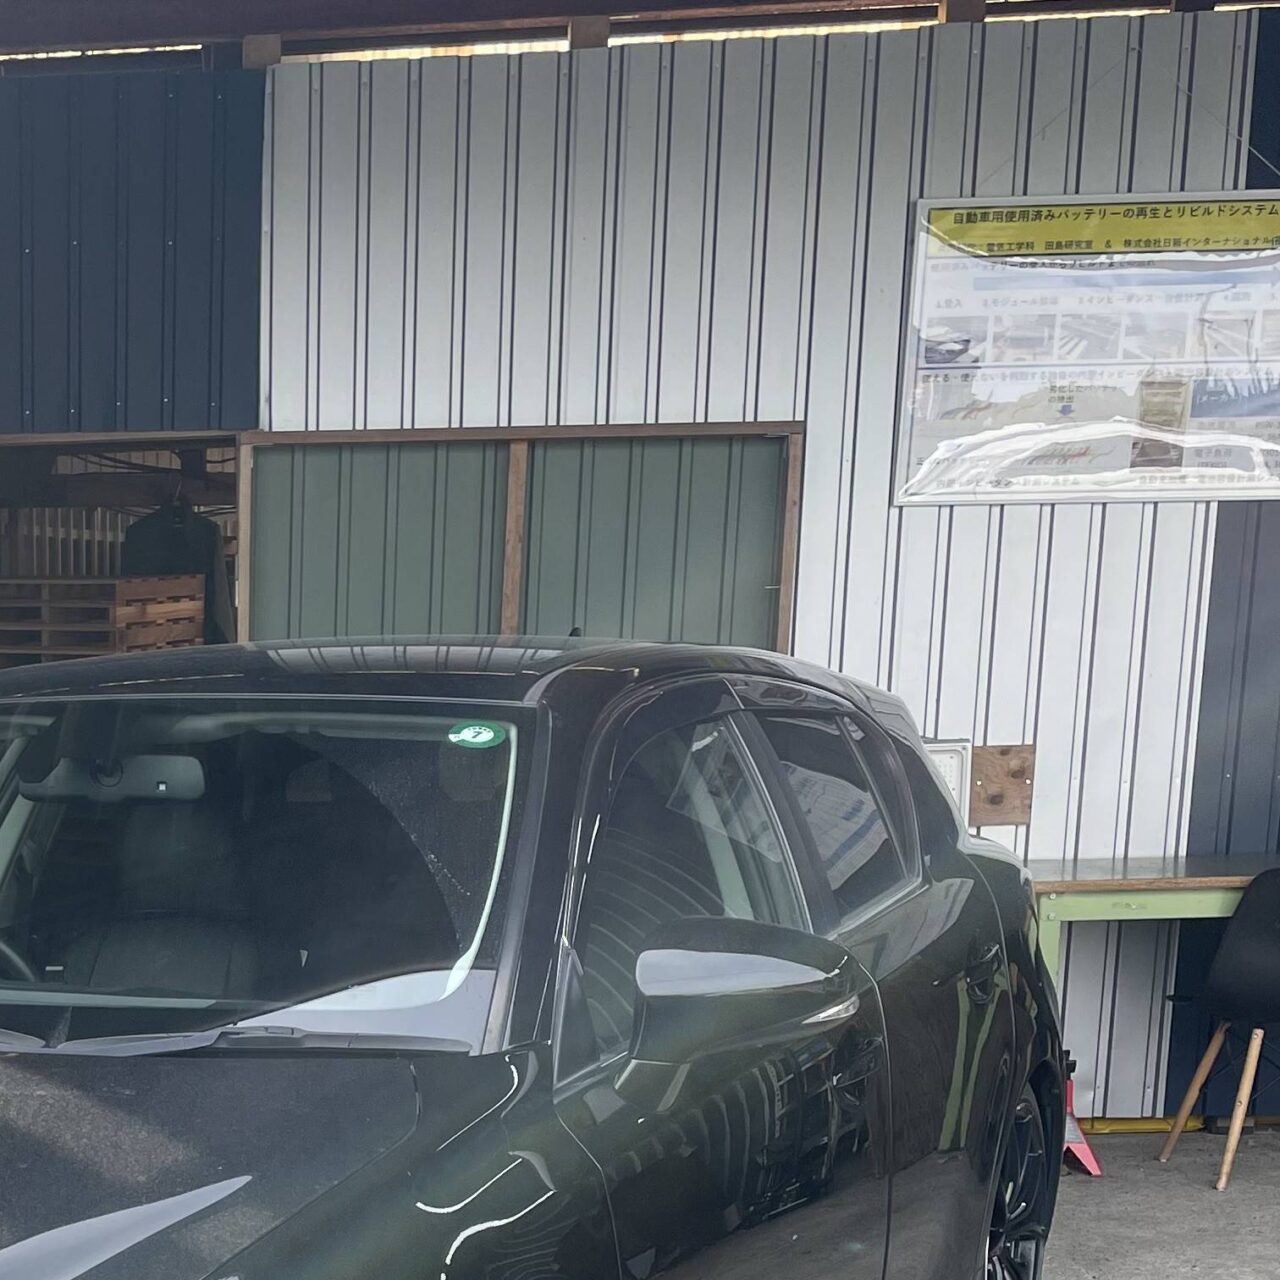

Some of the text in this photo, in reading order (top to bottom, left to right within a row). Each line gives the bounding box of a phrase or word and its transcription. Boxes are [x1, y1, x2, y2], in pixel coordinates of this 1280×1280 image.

[953, 204, 1280, 225] 自動車用使用済みバッテリーの再生とリビルドシステム
